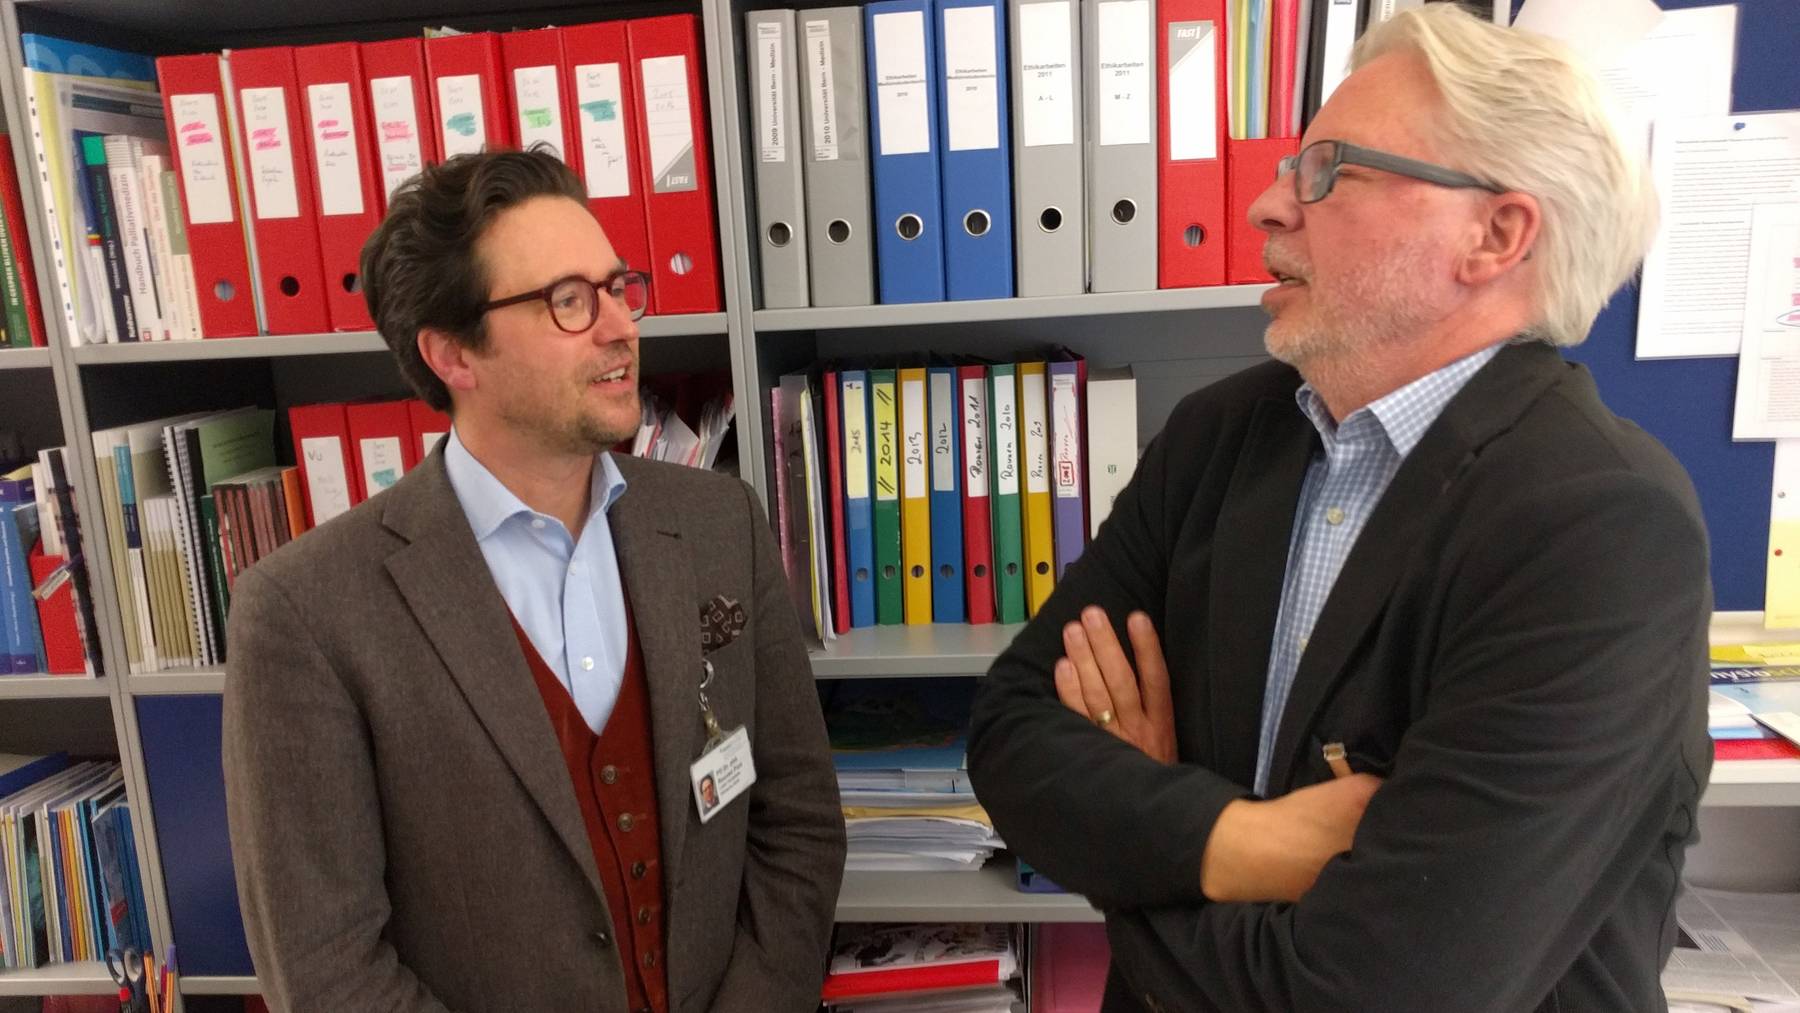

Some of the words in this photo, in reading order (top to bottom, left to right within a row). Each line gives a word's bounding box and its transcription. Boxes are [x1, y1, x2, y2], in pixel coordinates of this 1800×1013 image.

[1023, 62, 1066, 71] Ethikarbeiten
[1100, 61, 1144, 70] Ethikarbeiten
[822, 89, 830, 125] Universität
[120, 173, 138, 247] Palliativmedizin
[134, 249, 147, 295] Handbuch
[968, 395, 981, 429] 2011
[880, 421, 893, 467] 2014
[906, 431, 922, 465] 2013
[935, 423, 947, 454] 2012
